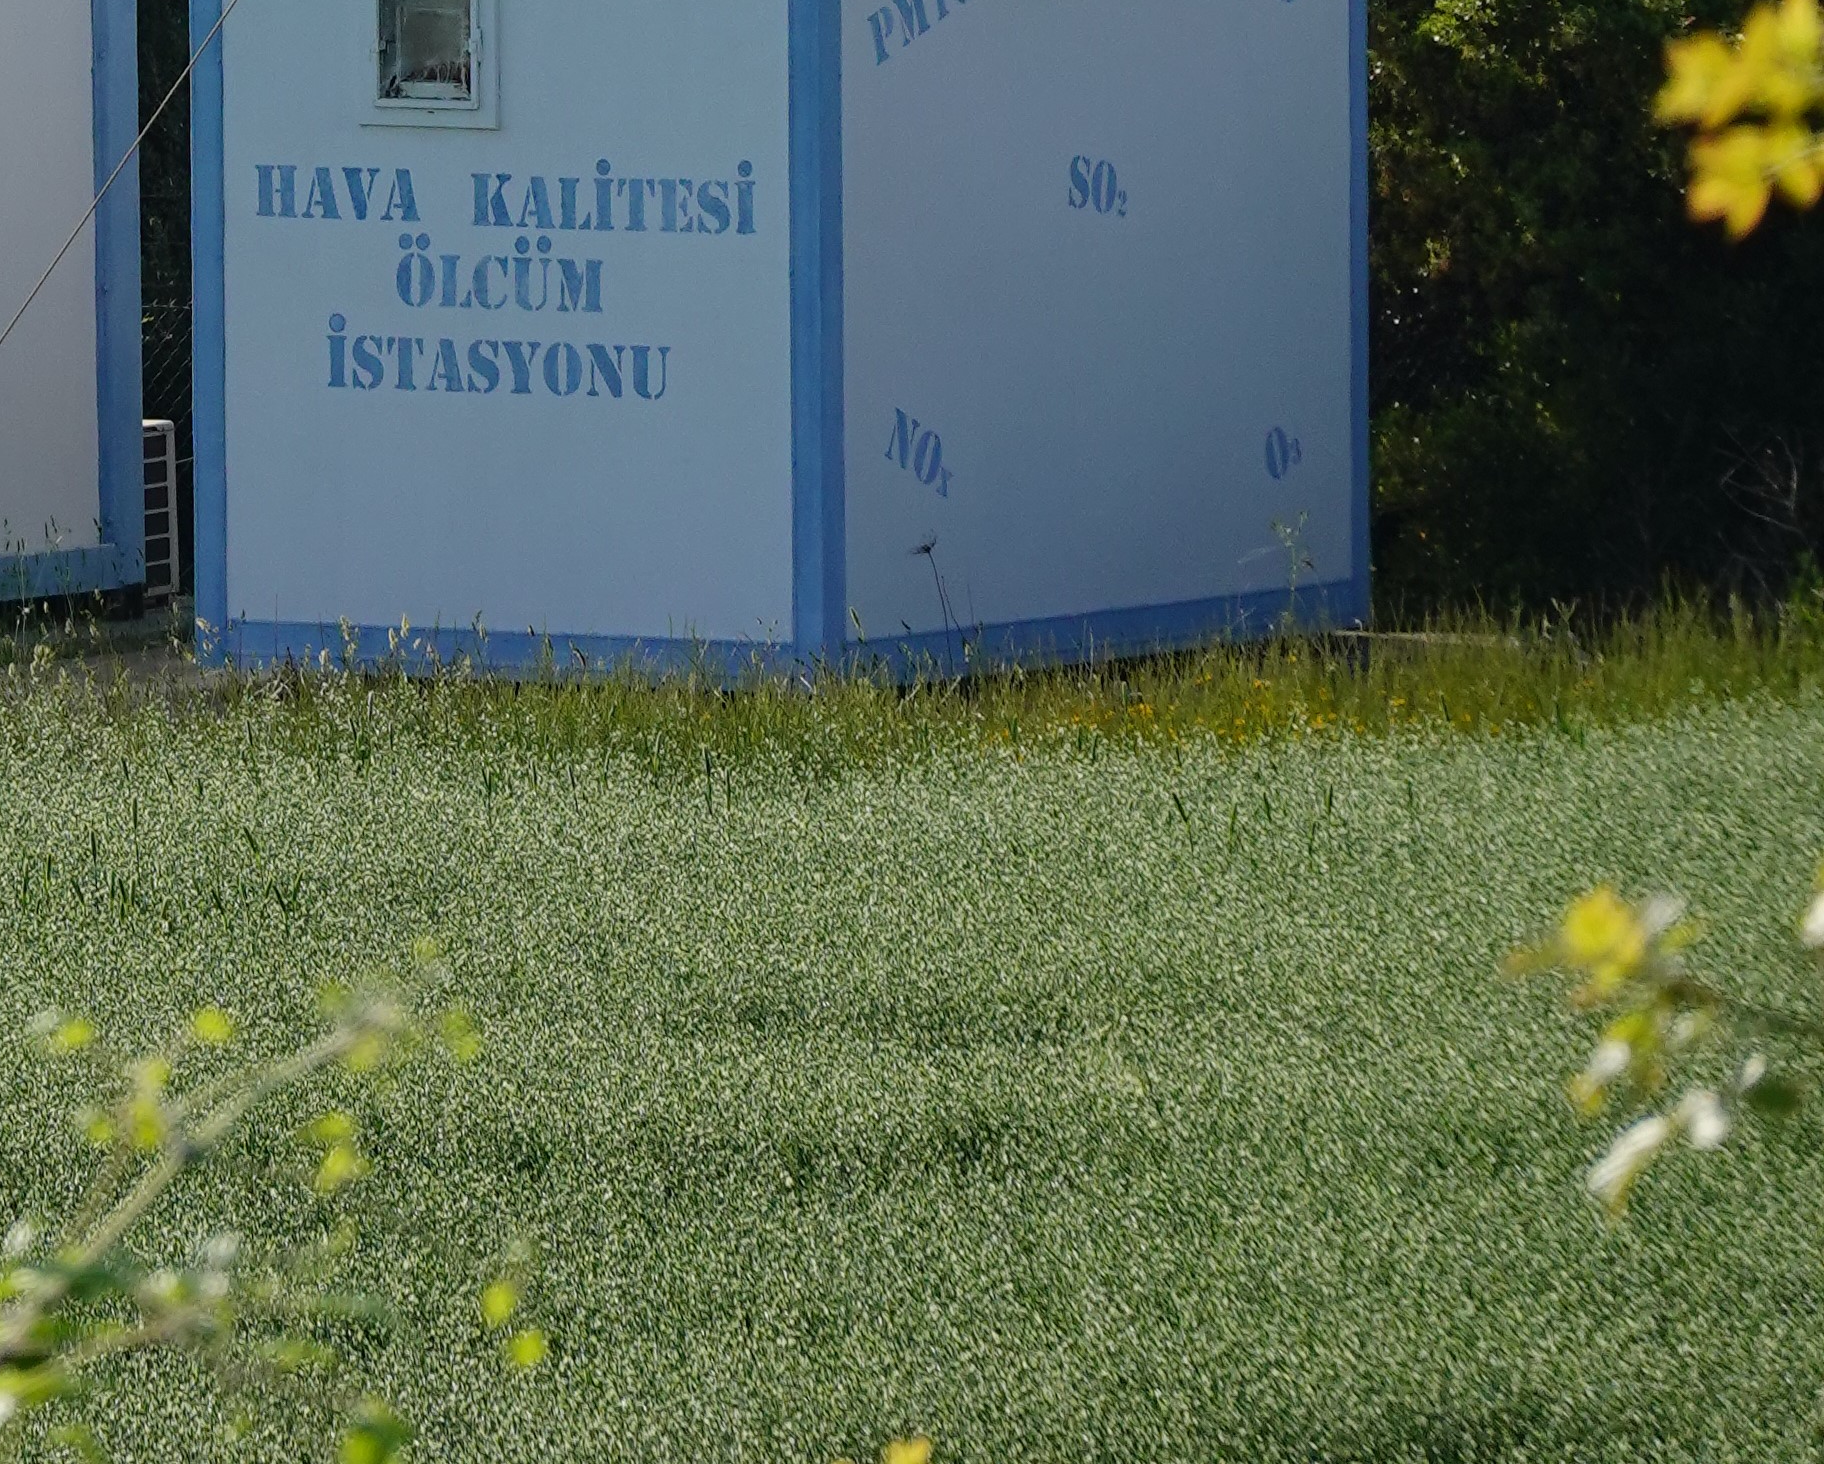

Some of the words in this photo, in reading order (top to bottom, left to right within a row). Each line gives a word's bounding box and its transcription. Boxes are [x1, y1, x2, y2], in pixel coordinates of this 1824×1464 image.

[255, 164, 421, 221] HAVA
[471, 158, 757, 235] KALİTESİ
[396, 233, 604, 313] ÖLCÜM
[327, 313, 671, 401] İSTASYONU
